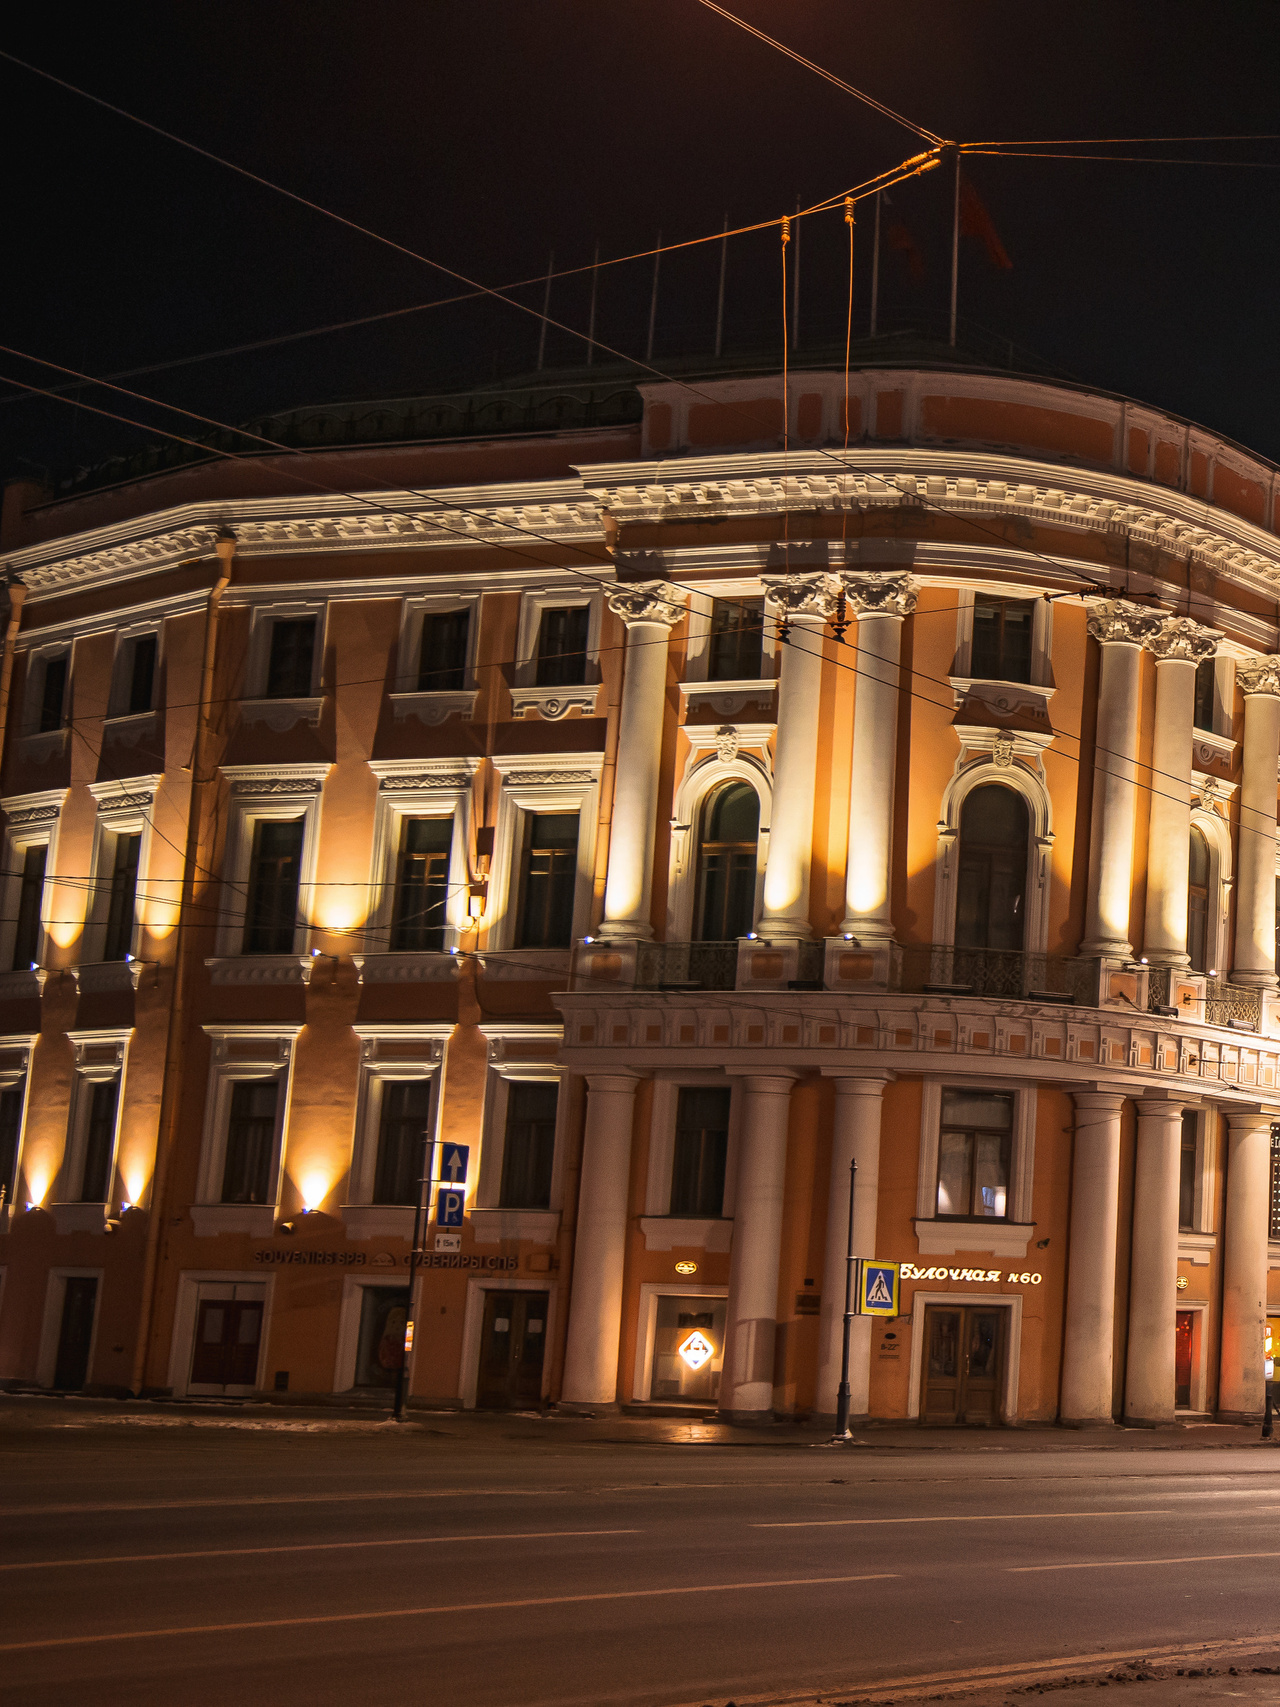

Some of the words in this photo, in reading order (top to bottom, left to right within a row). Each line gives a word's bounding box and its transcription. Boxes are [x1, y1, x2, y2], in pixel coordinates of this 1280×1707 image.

[444, 1192, 460, 1223] P
[255, 1250, 336, 1265] SOUVENIRS
[338, 1251, 366, 1266] SPB
[487, 1256, 519, 1270] СПБ
[900, 1262, 1002, 1282] Булочная
